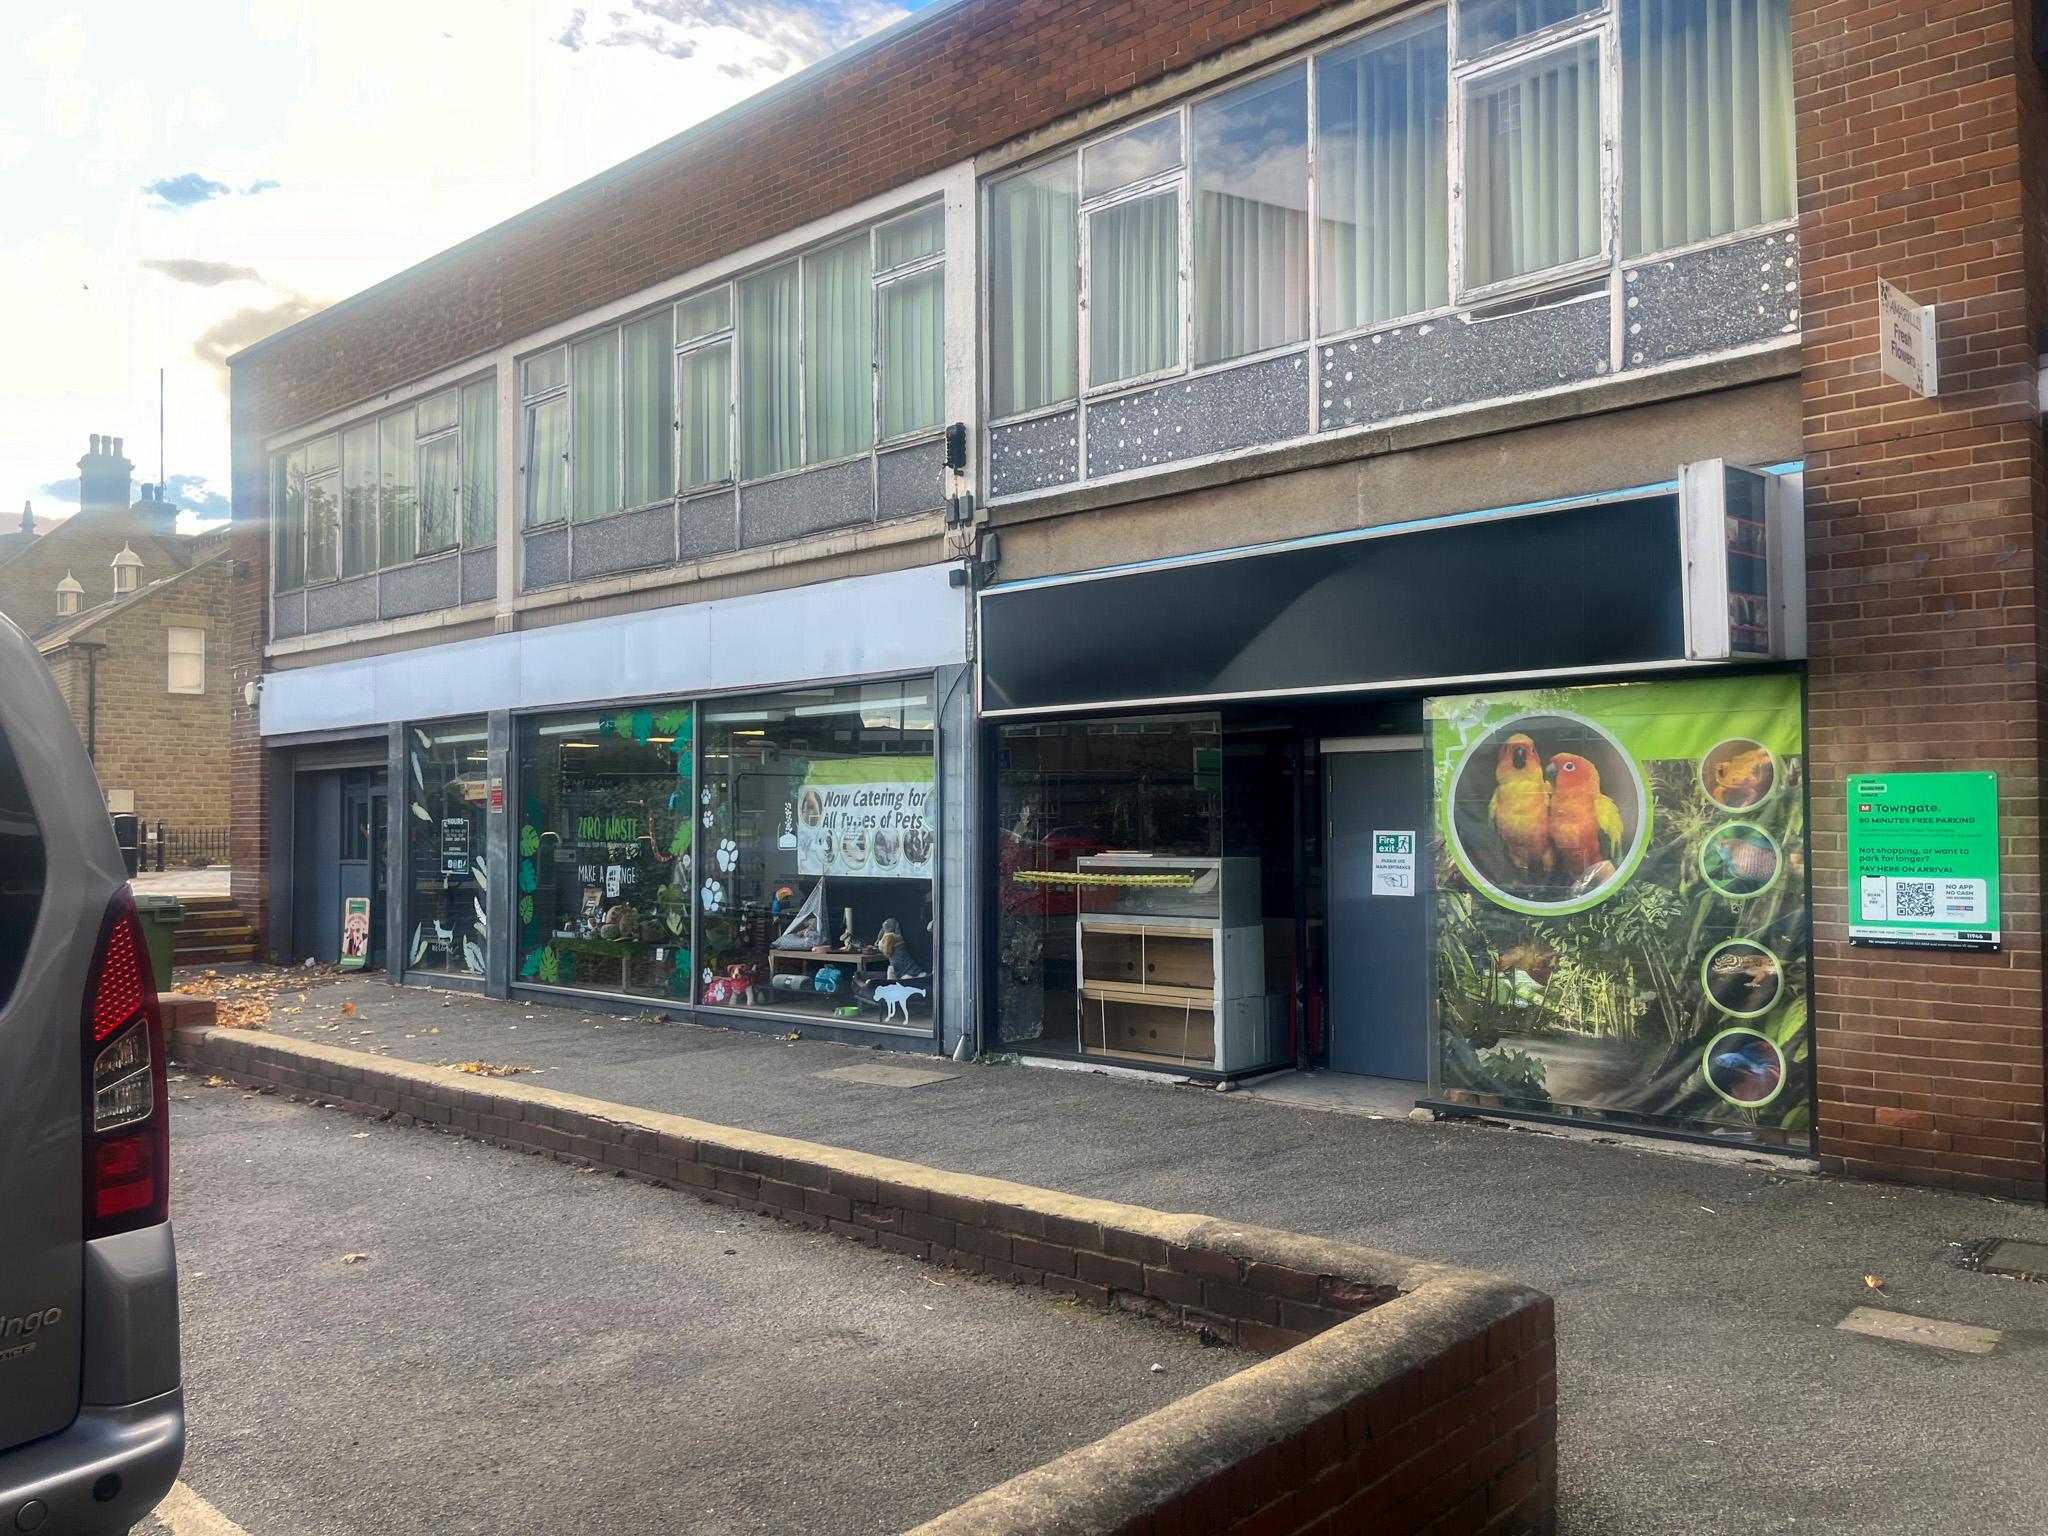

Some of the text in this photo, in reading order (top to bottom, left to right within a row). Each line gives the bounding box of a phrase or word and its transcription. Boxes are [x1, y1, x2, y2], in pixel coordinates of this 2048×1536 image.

[1893, 322, 1912, 349] Fresh
[1890, 341, 1916, 369] Flowers
[823, 788, 927, 811] Now Catering for
[577, 816, 639, 841] ZERO WASTE
[822, 811, 838, 829] All
[880, 811, 892, 829] of
[895, 811, 923, 830] Pets
[1378, 835, 1395, 844] Fire
[1859, 855, 1880, 863] park
[1895, 855, 1930, 864] longer?
[1876, 847, 1920, 856] shopping,
[577, 864, 597, 882] MAKE
[598, 865, 605, 883] A
